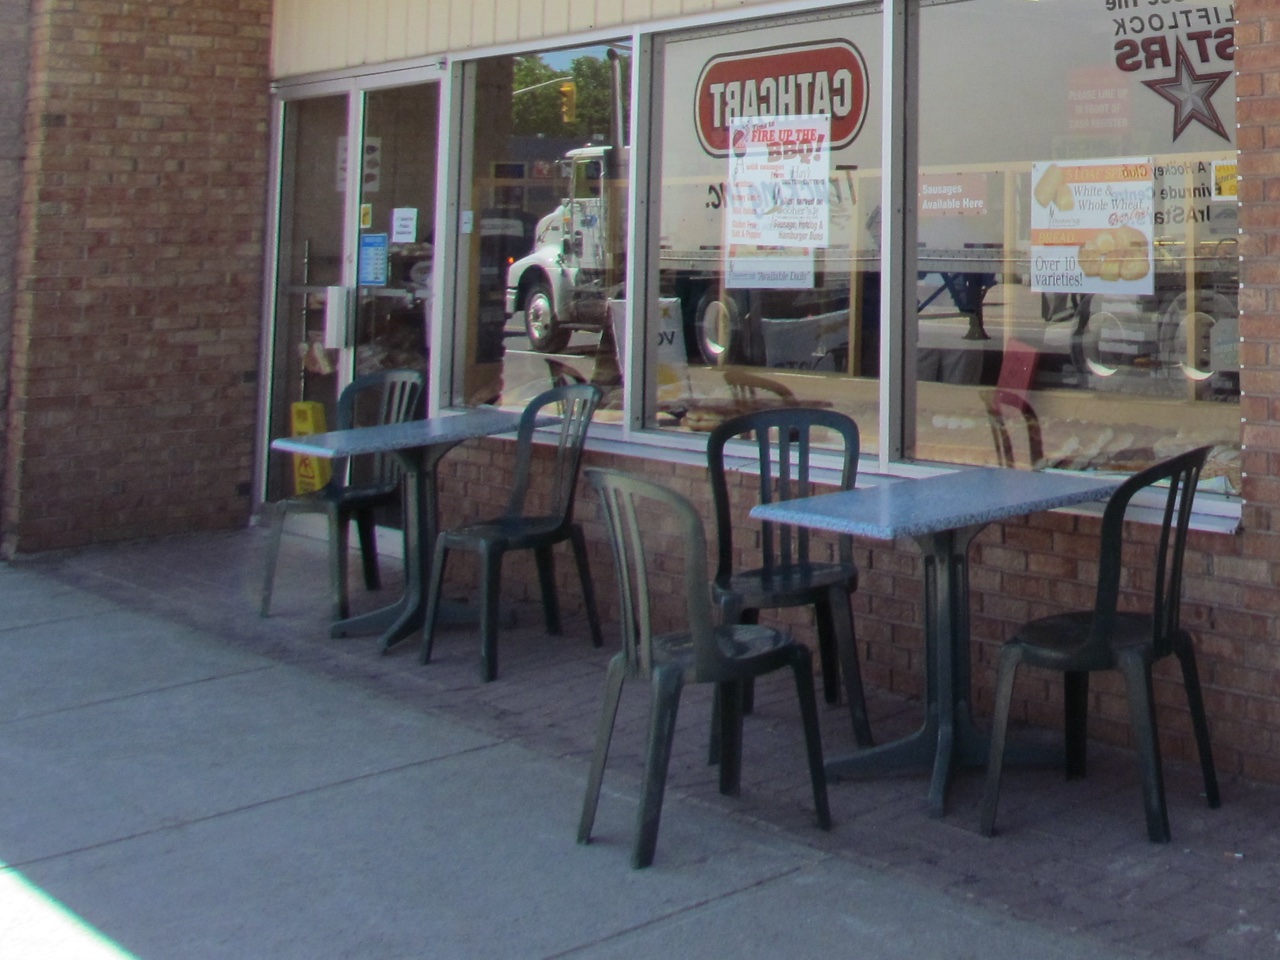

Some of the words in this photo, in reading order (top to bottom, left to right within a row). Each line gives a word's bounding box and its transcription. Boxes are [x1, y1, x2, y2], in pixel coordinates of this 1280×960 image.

[751, 129, 775, 143] FIRE
[778, 129, 793, 141] UP
[795, 128, 817, 141] THE
[767, 133, 826, 165] BBQ!
[922, 184, 963, 195] Sausages
[1073, 186, 1103, 197] White
[1104, 184, 1114, 196] &
[922, 198, 961, 210] Available
[962, 197, 984, 208] Here
[1078, 199, 1109, 211] Whole
[1111, 199, 1143, 210] Wheat
[1035, 256, 1061, 272] Over
[1064, 256, 1076, 271] 10
[1035, 272, 1083, 288] varieties!
